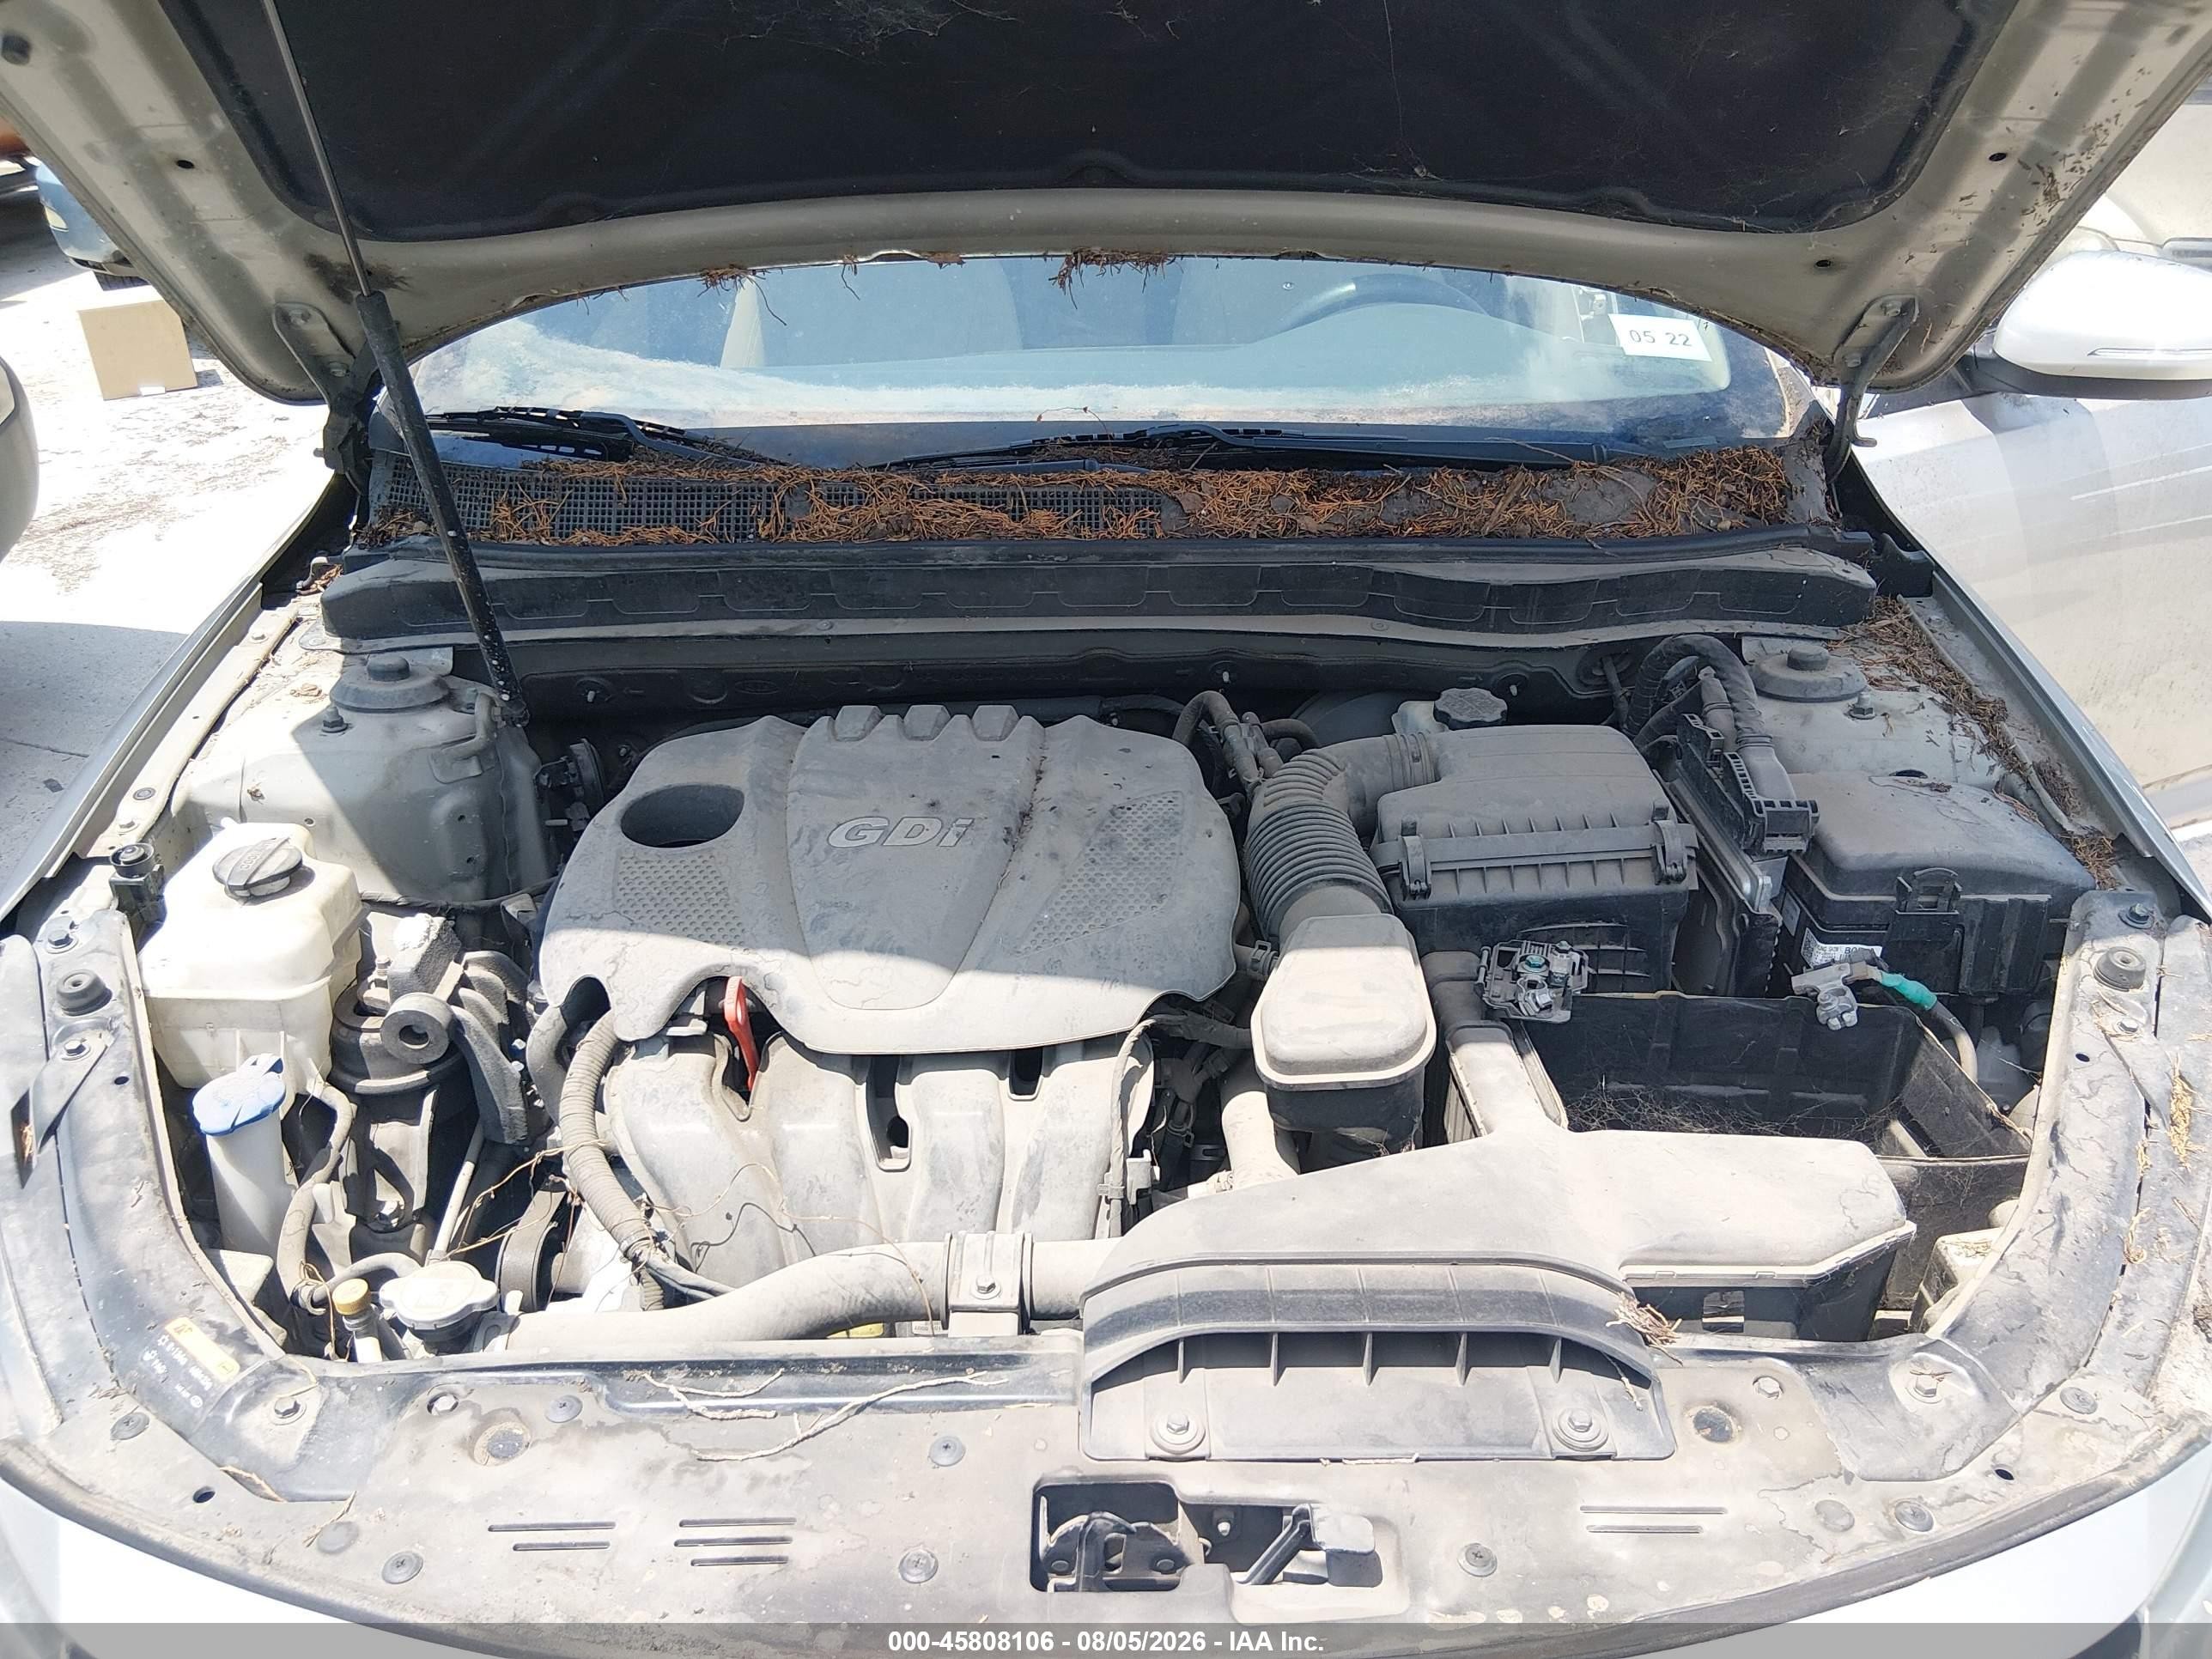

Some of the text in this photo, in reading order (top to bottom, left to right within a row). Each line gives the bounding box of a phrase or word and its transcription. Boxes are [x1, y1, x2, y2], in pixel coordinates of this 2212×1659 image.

[1629, 330, 1692, 347] 05 22
[826, 816, 974, 848] GDi
